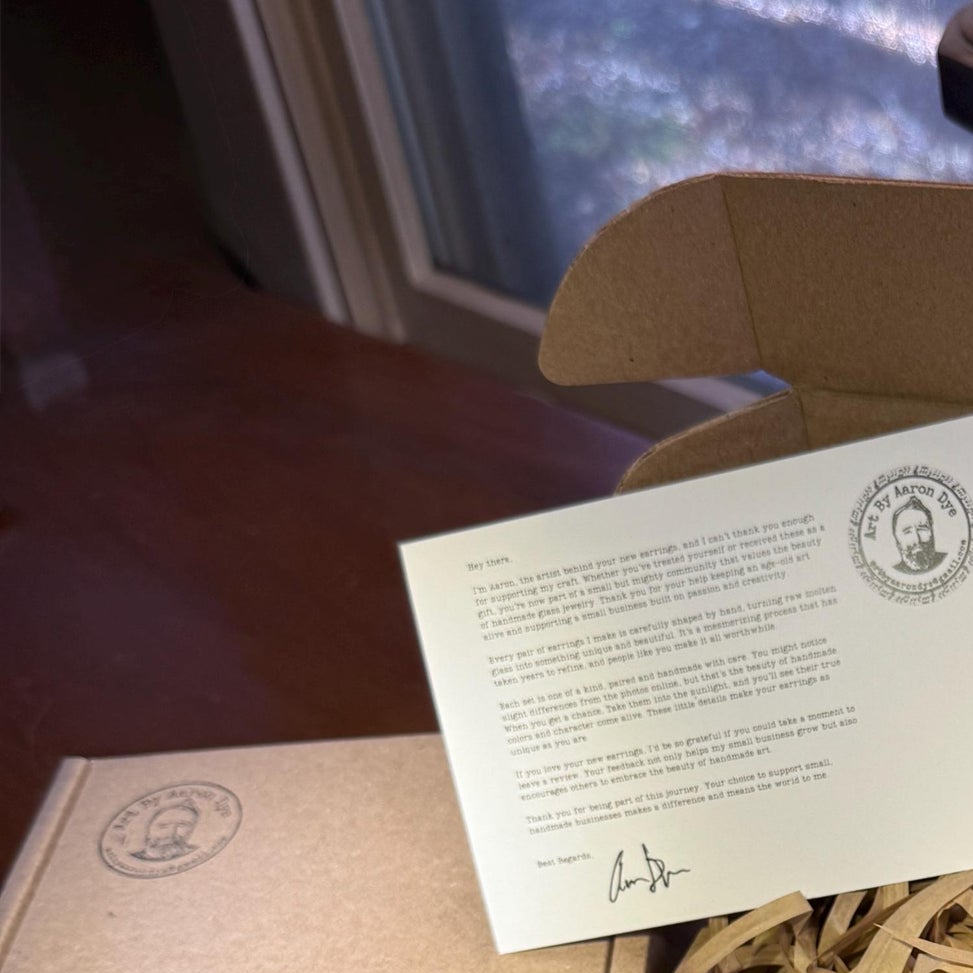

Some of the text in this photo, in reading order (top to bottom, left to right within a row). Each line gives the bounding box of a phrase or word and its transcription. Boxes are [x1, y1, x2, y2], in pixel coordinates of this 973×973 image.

[864, 484, 957, 541] Art By Aaron Dye
[489, 585, 538, 604] supporting
[582, 568, 620, 582] Whether
[687, 545, 725, 562] yourself
[739, 534, 777, 549] received
[535, 568, 560, 580] artist
[562, 561, 593, 575] behind
[781, 514, 815, 529] enough
[630, 571, 664, 586] mighty
[665, 559, 717, 578] community
[741, 548, 771, 561] values
[790, 537, 822, 552] beauty
[491, 610, 536, 626] handmade
[709, 566, 745, 582] keeping
[523, 615, 572, 633] supporting
[608, 599, 647, 614] business
[686, 584, 721, 599] passion
[533, 650, 580, 667] something
[581, 643, 613, 657] unique
[702, 612, 762, 633] mesmerizing
[763, 606, 797, 620] process
[546, 637, 585, 653] earrings
[628, 619, 669, 636] carefully
[670, 612, 703, 627] shaped
[746, 596, 783, 612] turning
[606, 651, 634, 665] people
[606, 675, 636, 689] paired
[656, 661, 702, 677] handmade
[800, 636, 827, 648] notice
[500, 709, 527, 722] slight
[528, 699, 577, 715] differences
[619, 685, 649, 698] photos
[745, 659, 776, 673] beauty
[506, 732, 533, 744] colors
[552, 720, 594, 735] character
[674, 700, 695, 711] little
[697, 694, 727, 706] details
[778, 676, 818, 692] earrings
[509, 743, 541, 757] unique
[606, 758, 644, 772] feedback
[755, 729, 794, 743] business
[685, 731, 722, 746] grateful
[807, 707, 844, 721] moment
[520, 749, 754, 802] encourages others embrace beauty handmade
[727, 773, 755, 785] choice
[768, 764, 803, 778] support
[528, 819, 573, 834] handmade
[574, 810, 622, 825] businesses
[661, 794, 705, 809] difference
